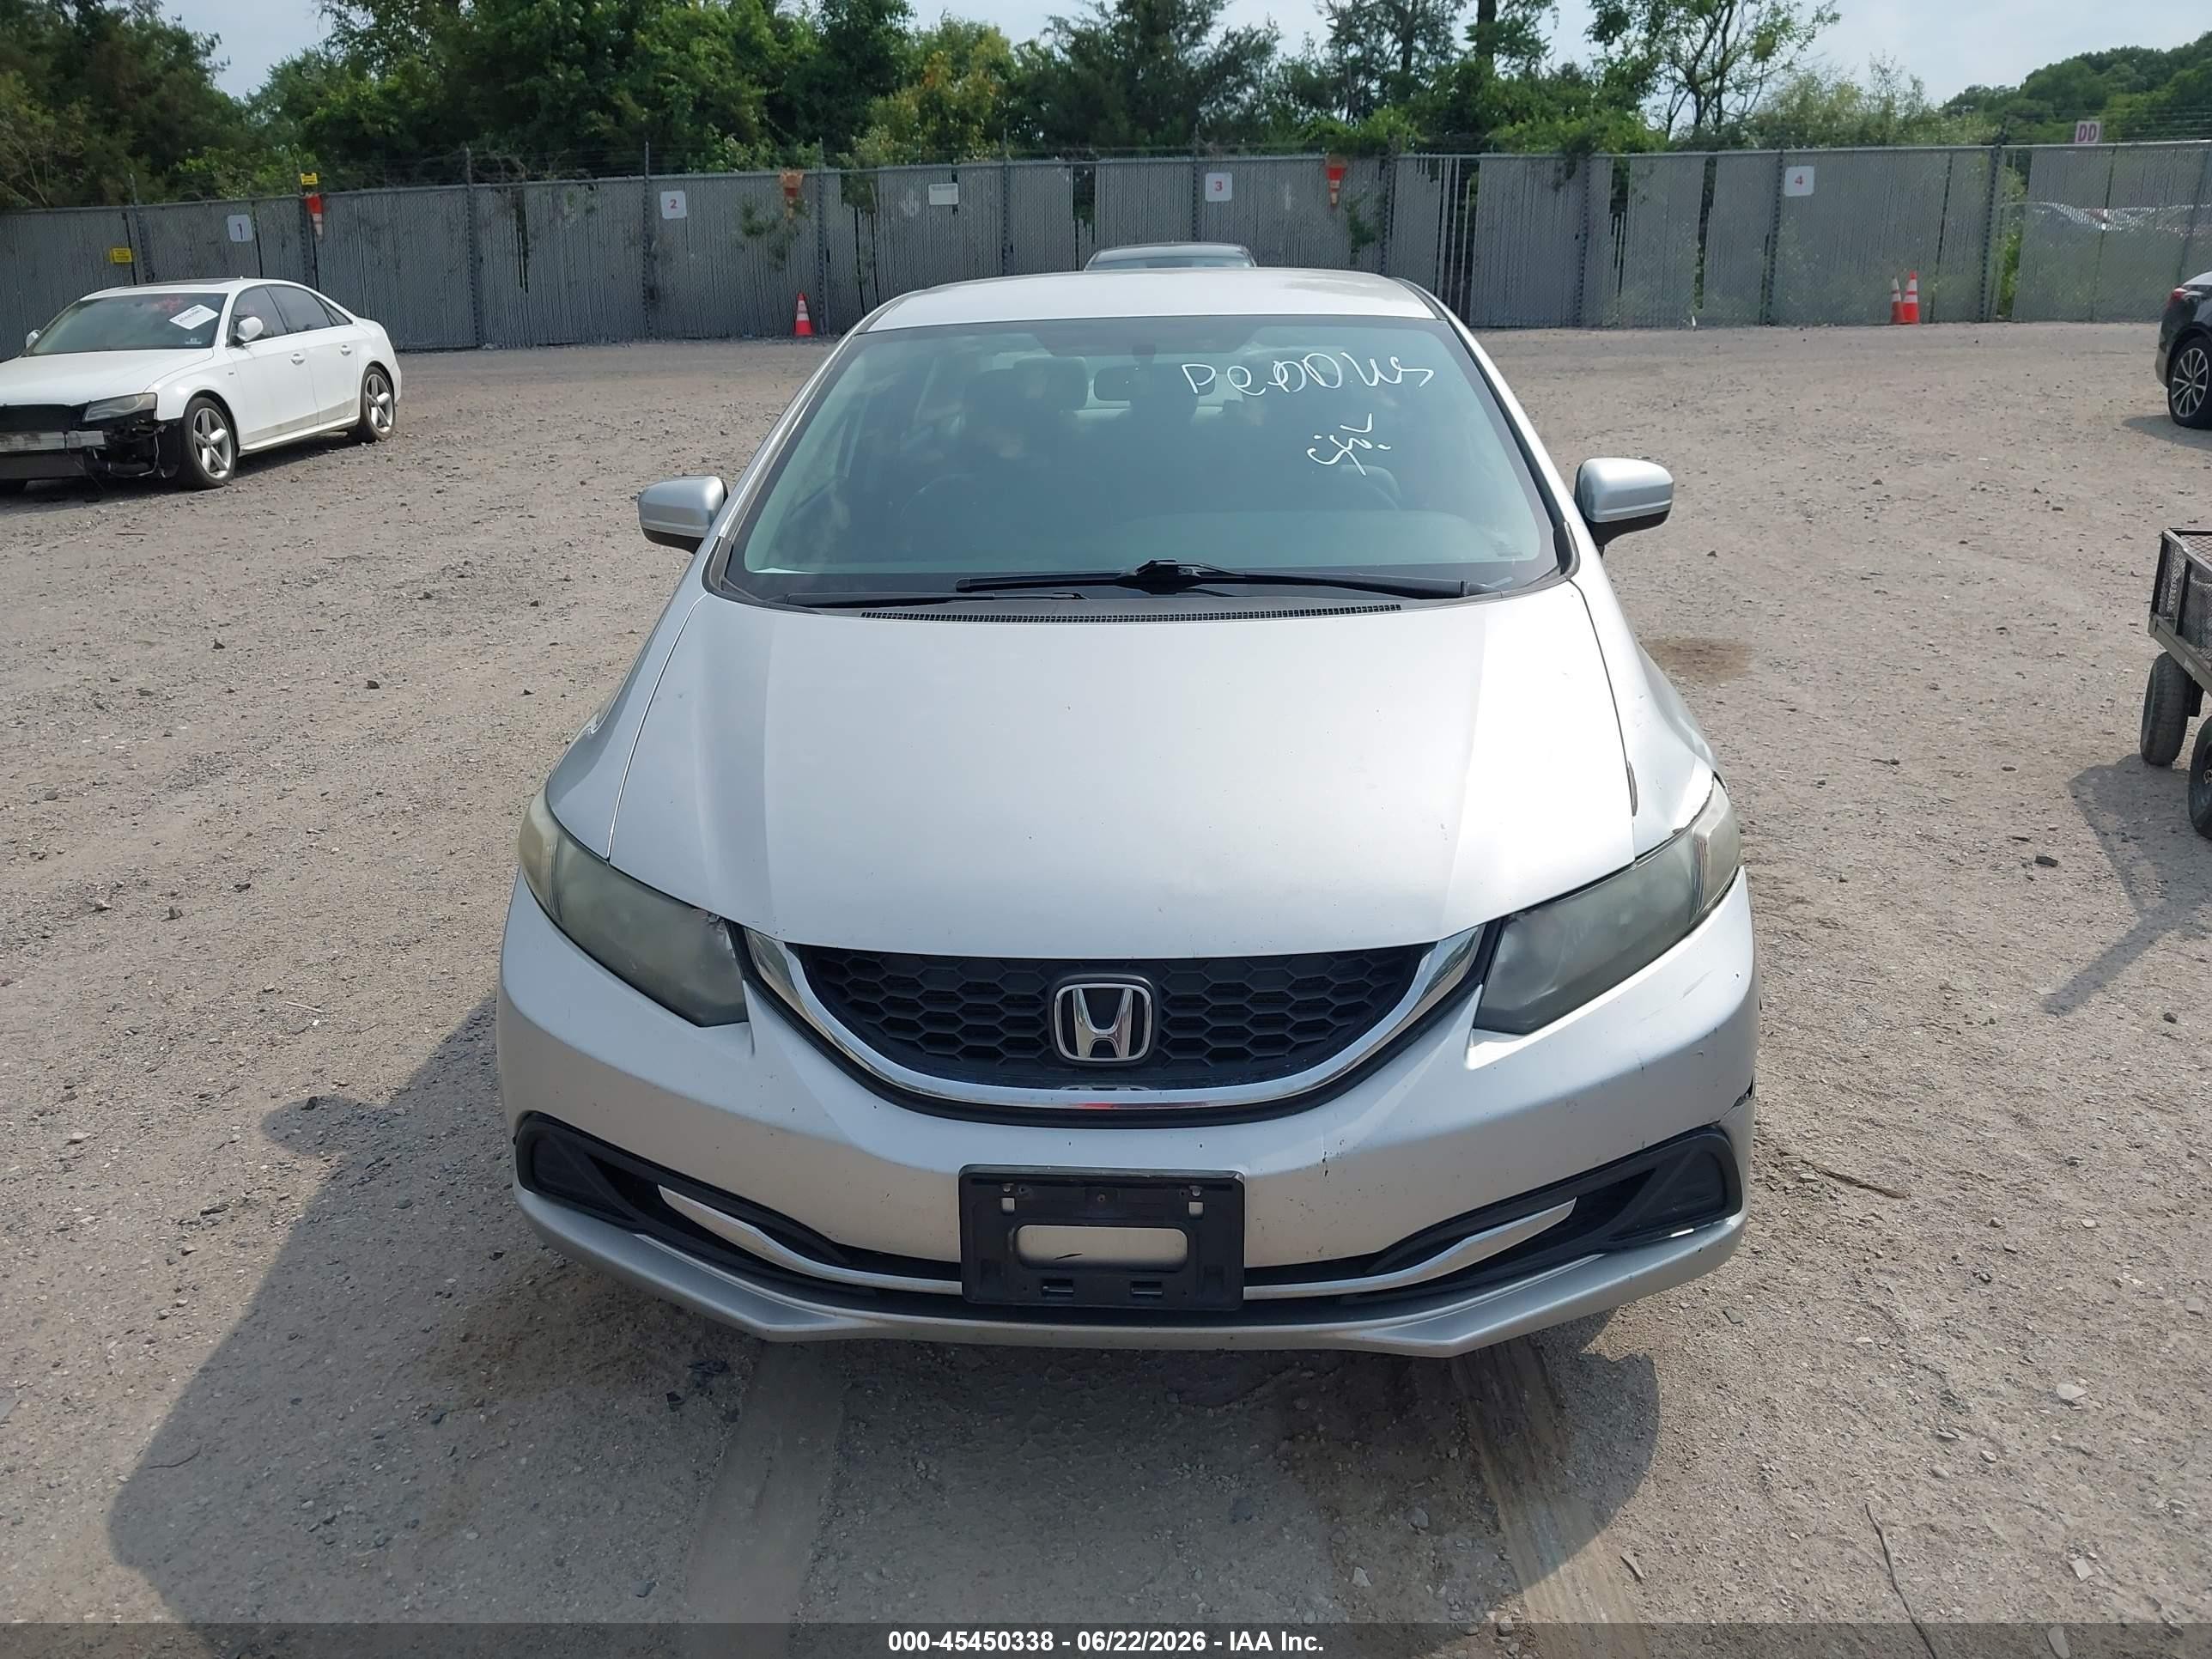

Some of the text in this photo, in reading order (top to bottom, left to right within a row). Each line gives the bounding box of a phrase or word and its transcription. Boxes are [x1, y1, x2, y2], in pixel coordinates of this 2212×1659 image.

[2078, 124, 2097, 142] DD
[1794, 174, 1803, 185] 4
[1215, 180, 1224, 192] 3
[670, 198, 678, 210] 2
[237, 222, 244, 241] 1
